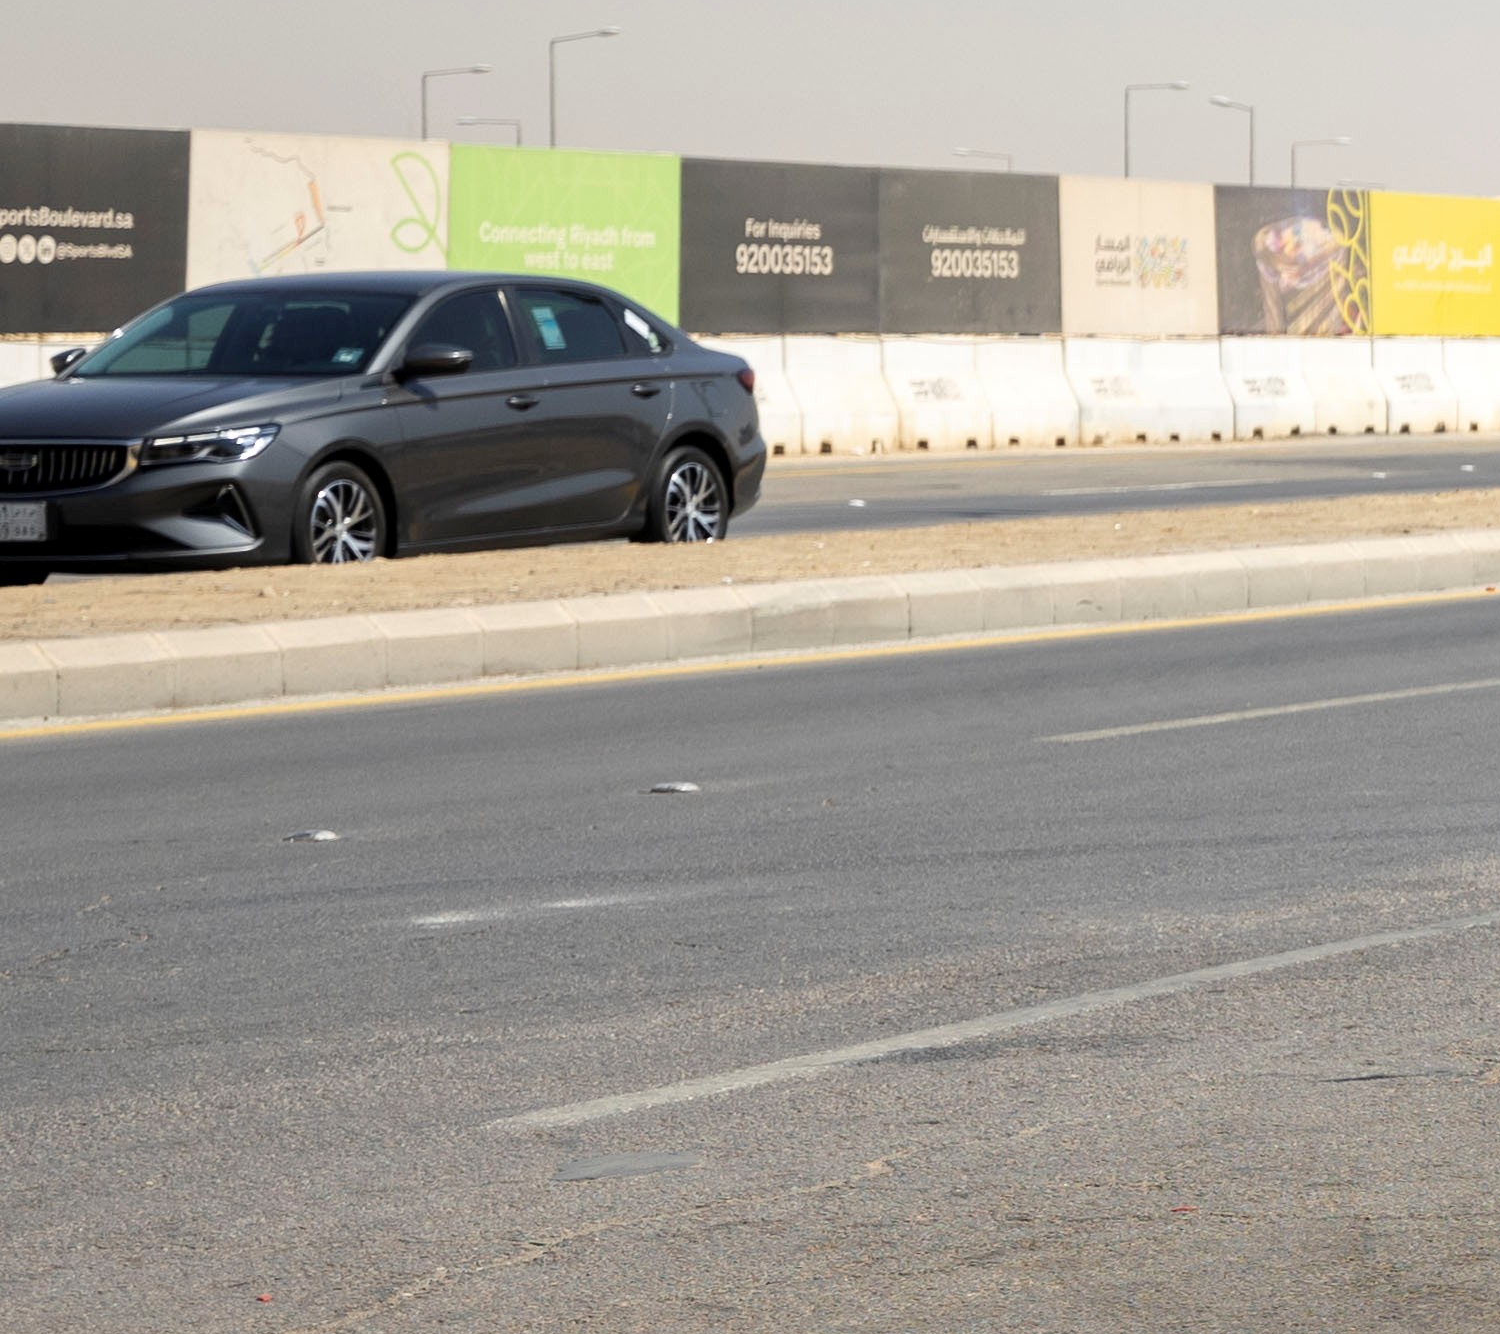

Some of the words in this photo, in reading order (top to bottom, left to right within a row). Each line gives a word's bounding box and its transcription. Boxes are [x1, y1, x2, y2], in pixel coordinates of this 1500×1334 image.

[479, 220, 567, 250] Connecting
[569, 223, 619, 250] Riyadh
[622, 225, 656, 248] from
[745, 217, 767, 238] For
[524, 250, 560, 270] west
[563, 250, 579, 269] to
[582, 252, 614, 271] east
[736, 243, 833, 276] 920035153
[931, 248, 1019, 279] 920035153
